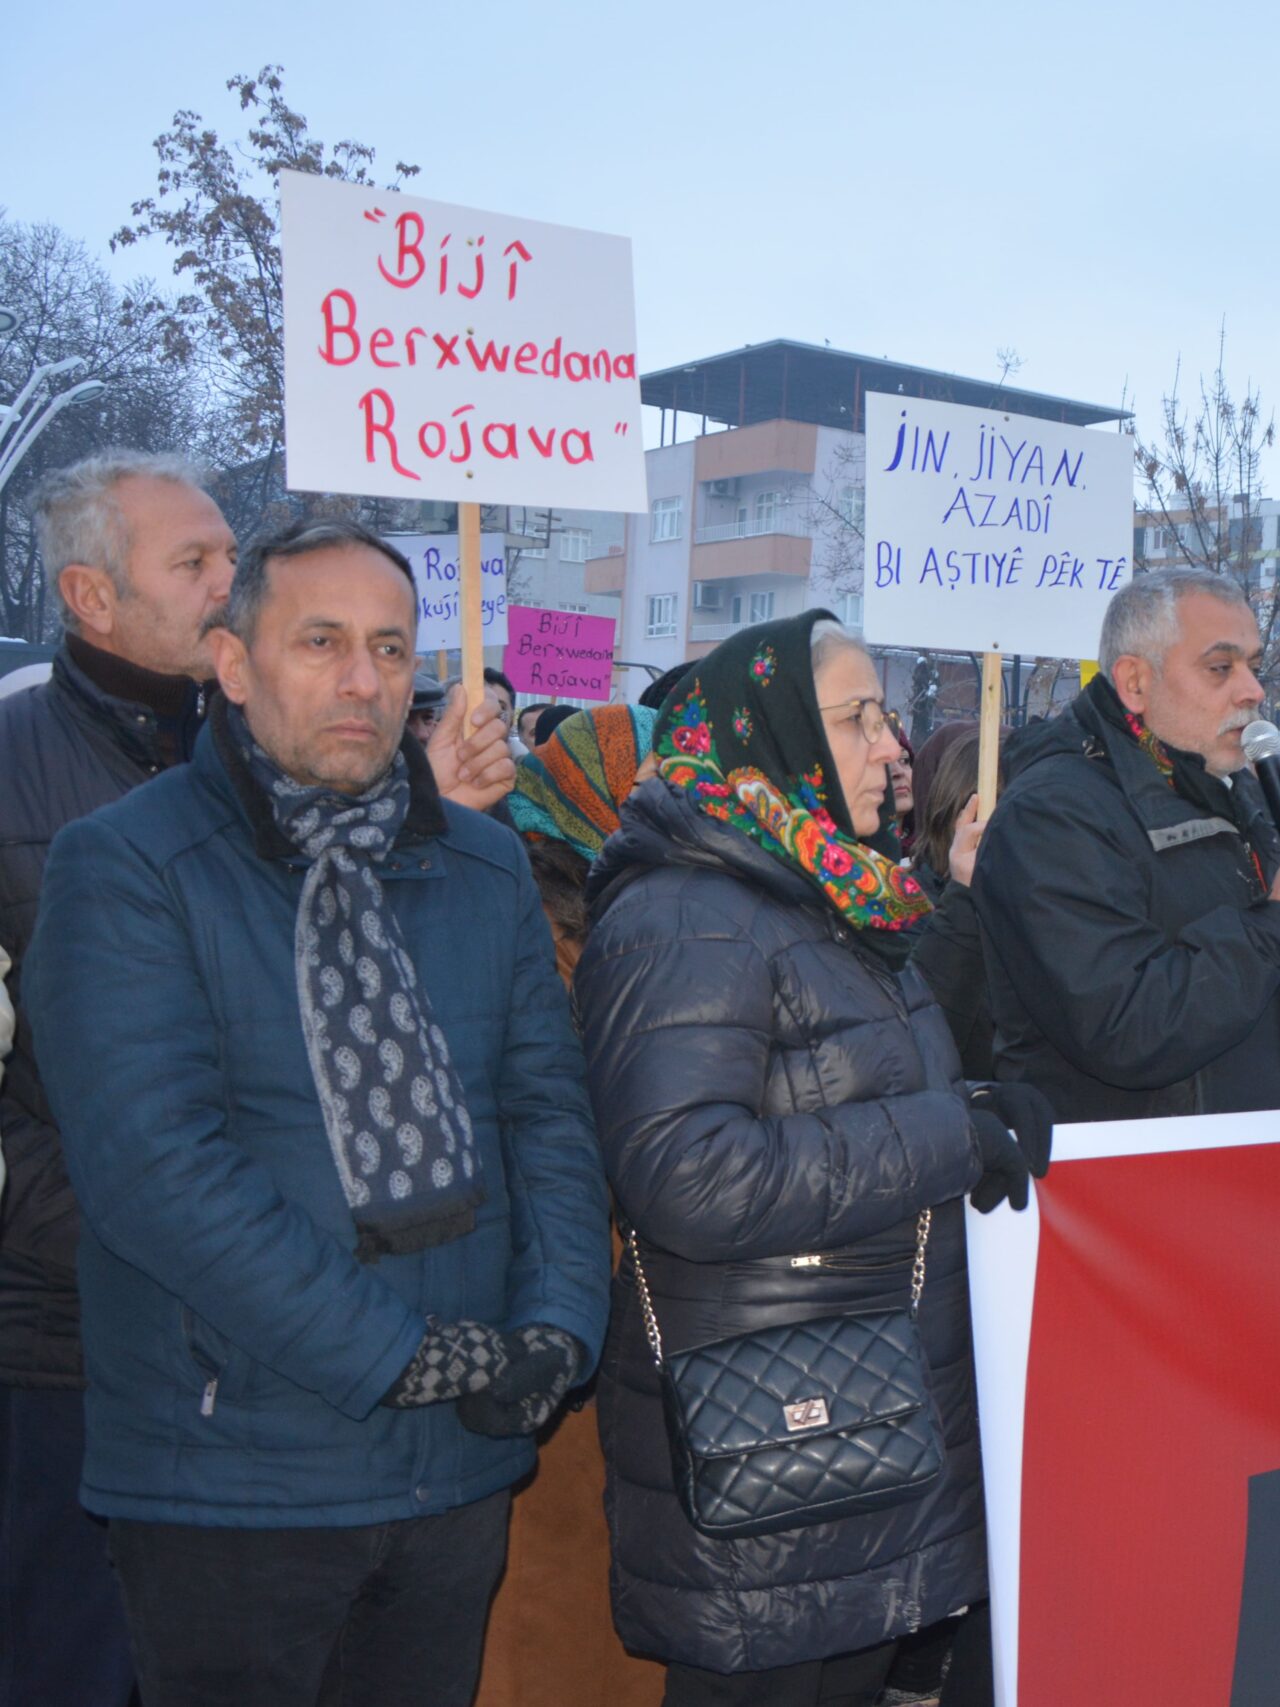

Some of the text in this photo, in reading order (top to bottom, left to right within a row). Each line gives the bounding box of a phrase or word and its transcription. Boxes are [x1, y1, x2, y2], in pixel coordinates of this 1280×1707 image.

[318, 288, 637, 382] Berxwedana
[942, 486, 1053, 534] AZADÎ
[875, 541, 901, 588] BI
[1035, 551, 1084, 588] PÊK
[1096, 556, 1127, 590] TÊ
